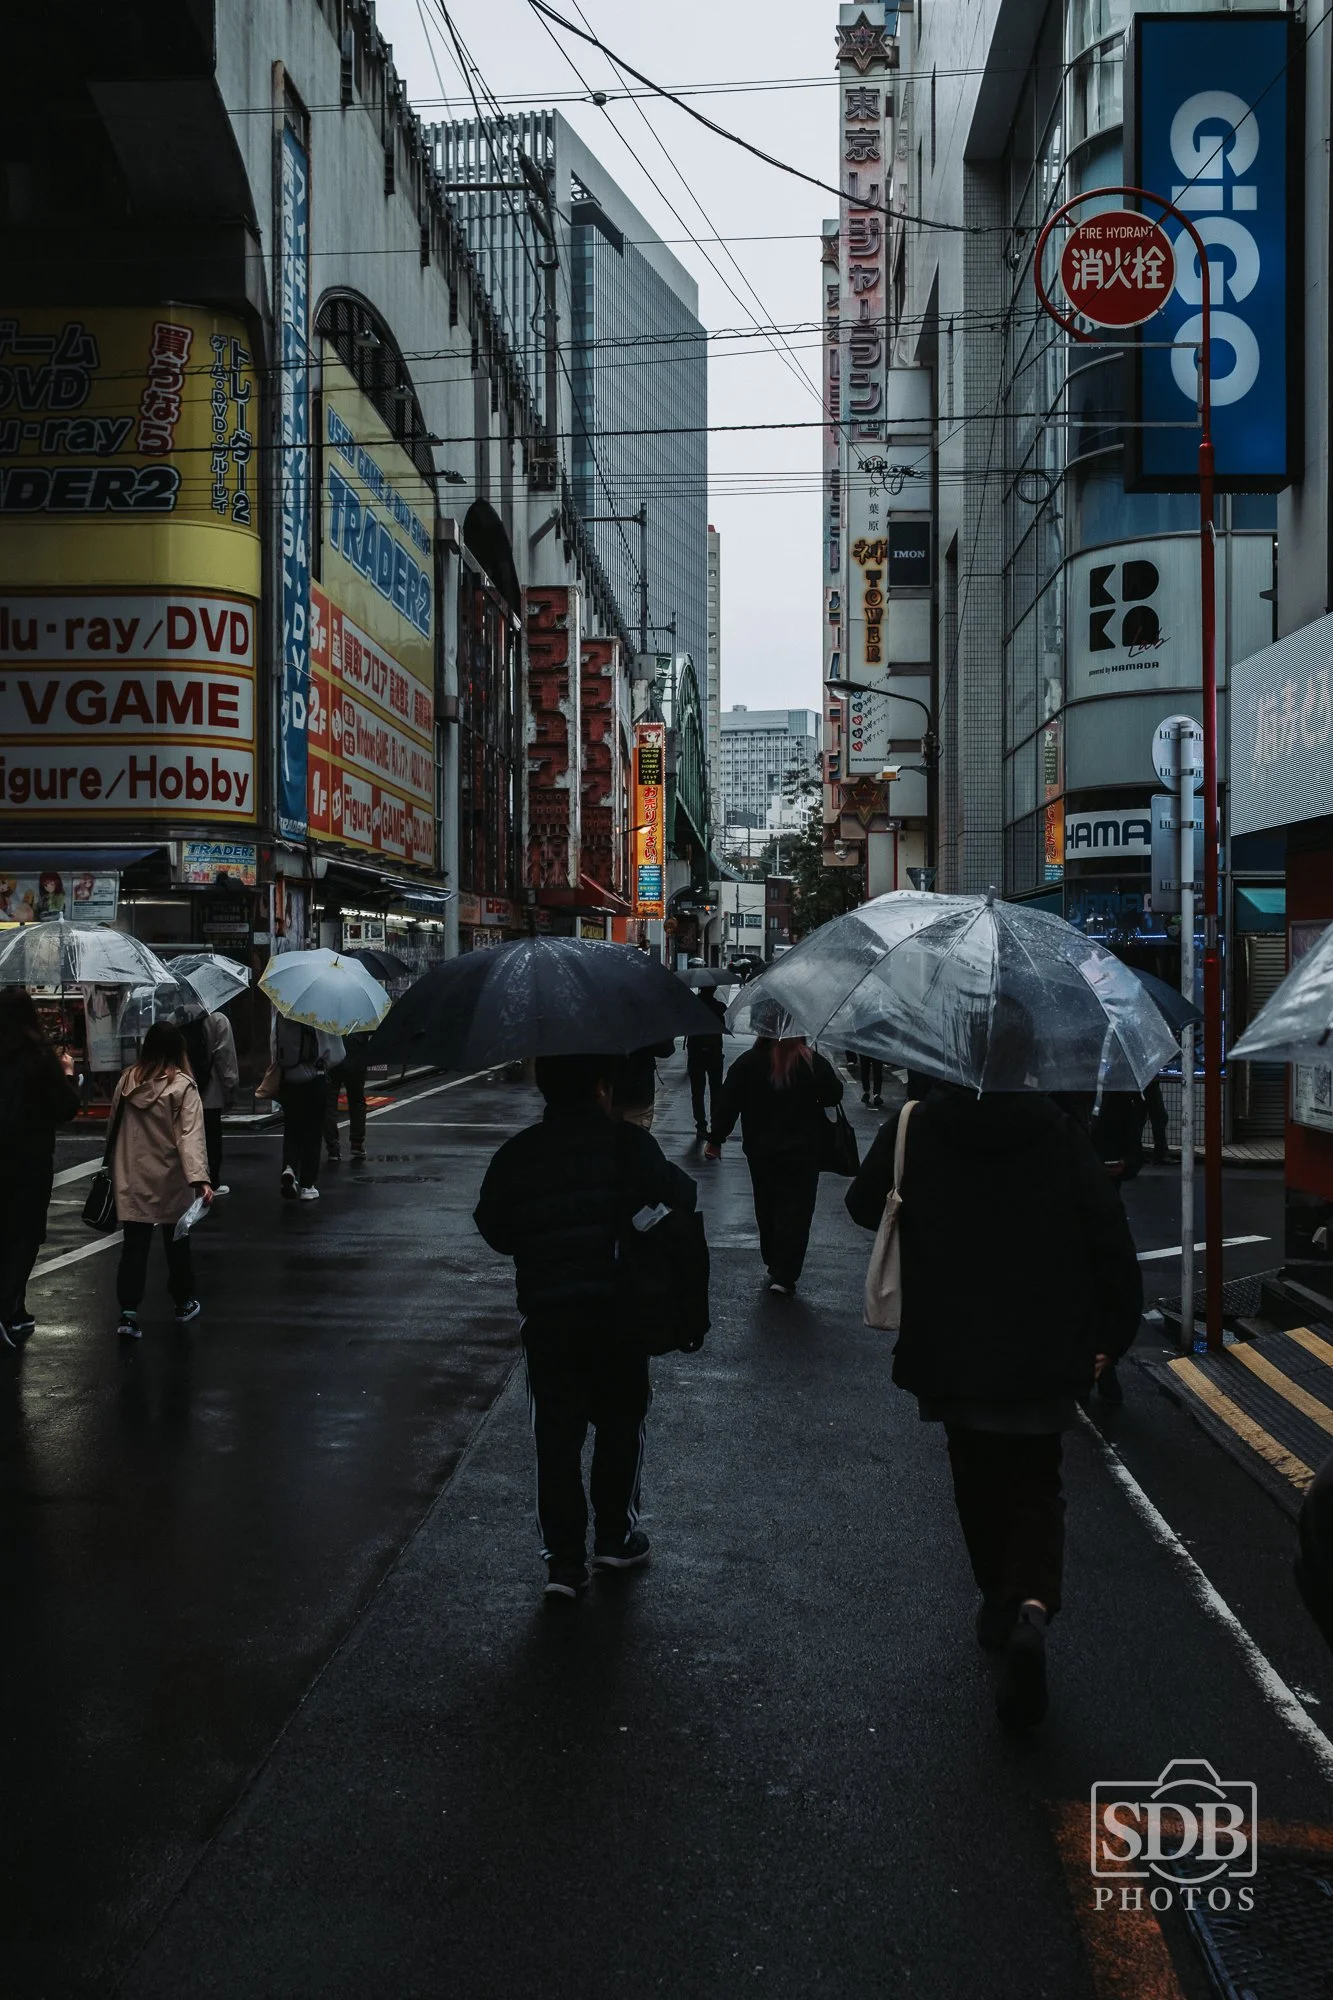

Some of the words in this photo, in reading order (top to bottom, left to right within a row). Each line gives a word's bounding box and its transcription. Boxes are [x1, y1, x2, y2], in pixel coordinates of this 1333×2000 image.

[1080, 227, 1103, 239] FIRE
[1106, 226, 1154, 238] HYDRANT
[1071, 246, 1166, 291] 消火栓
[137, 322, 193, 457] 買うなら
[230, 336, 252, 527] トレーダー2
[327, 405, 355, 468] USED
[0, 466, 182, 513] DER2
[868, 487, 880, 531] 秋葉原
[328, 462, 431, 640] TRADER2
[893, 550, 926, 559] IMON
[310, 601, 327, 654] 3F
[1112, 661, 1159, 673] HAMADA
[0, 679, 240, 729] VGAME
[308, 686, 327, 737] 2F
[312, 771, 328, 818] 1F
[343, 783, 372, 834] Figure
[381, 801, 405, 846] GAME
[187, 844, 255, 858] TRADER2
[1066, 819, 1151, 850] HAMA
